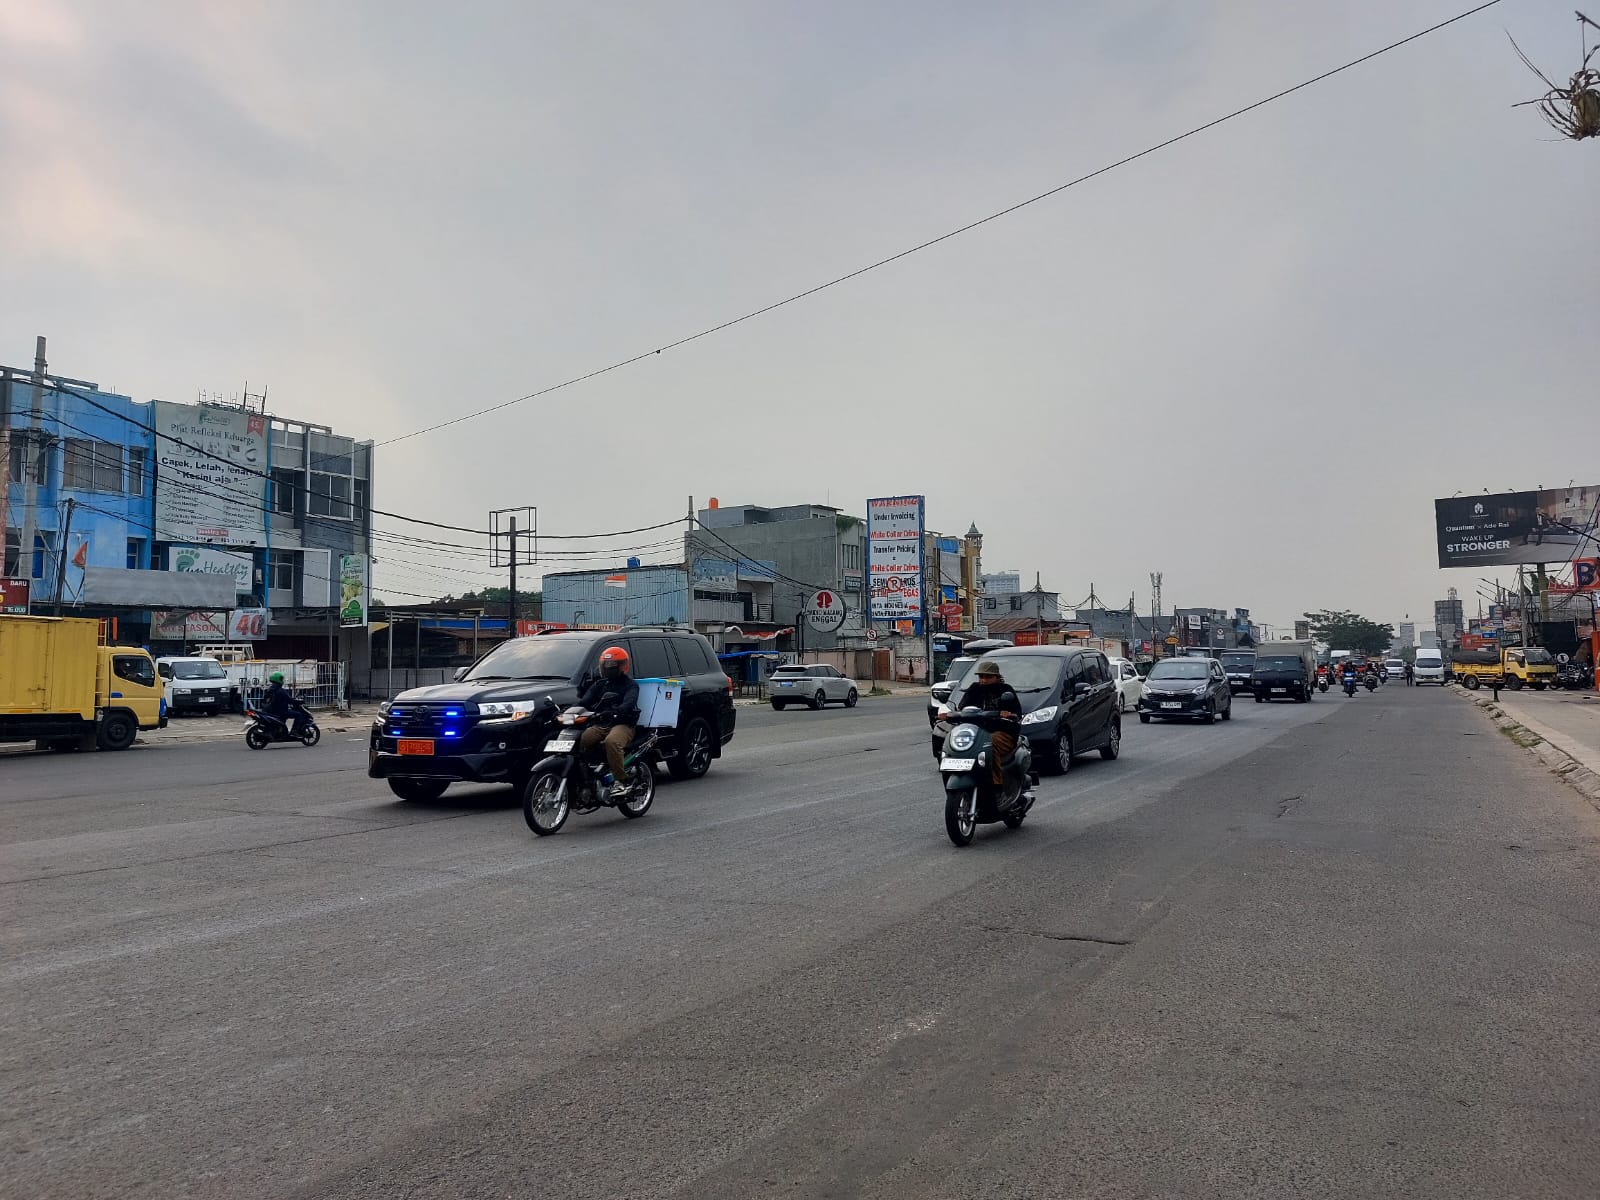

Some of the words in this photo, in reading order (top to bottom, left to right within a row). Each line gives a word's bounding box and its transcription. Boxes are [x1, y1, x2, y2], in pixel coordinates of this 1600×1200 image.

[195, 461, 225, 474] Lelah,
[873, 513, 890, 521] Under
[891, 511, 915, 520] Invoicing
[873, 545, 895, 554] Transfer
[896, 544, 916, 554] Pricing
[1446, 540, 1511, 552] STRONGER
[870, 564, 886, 572] White
